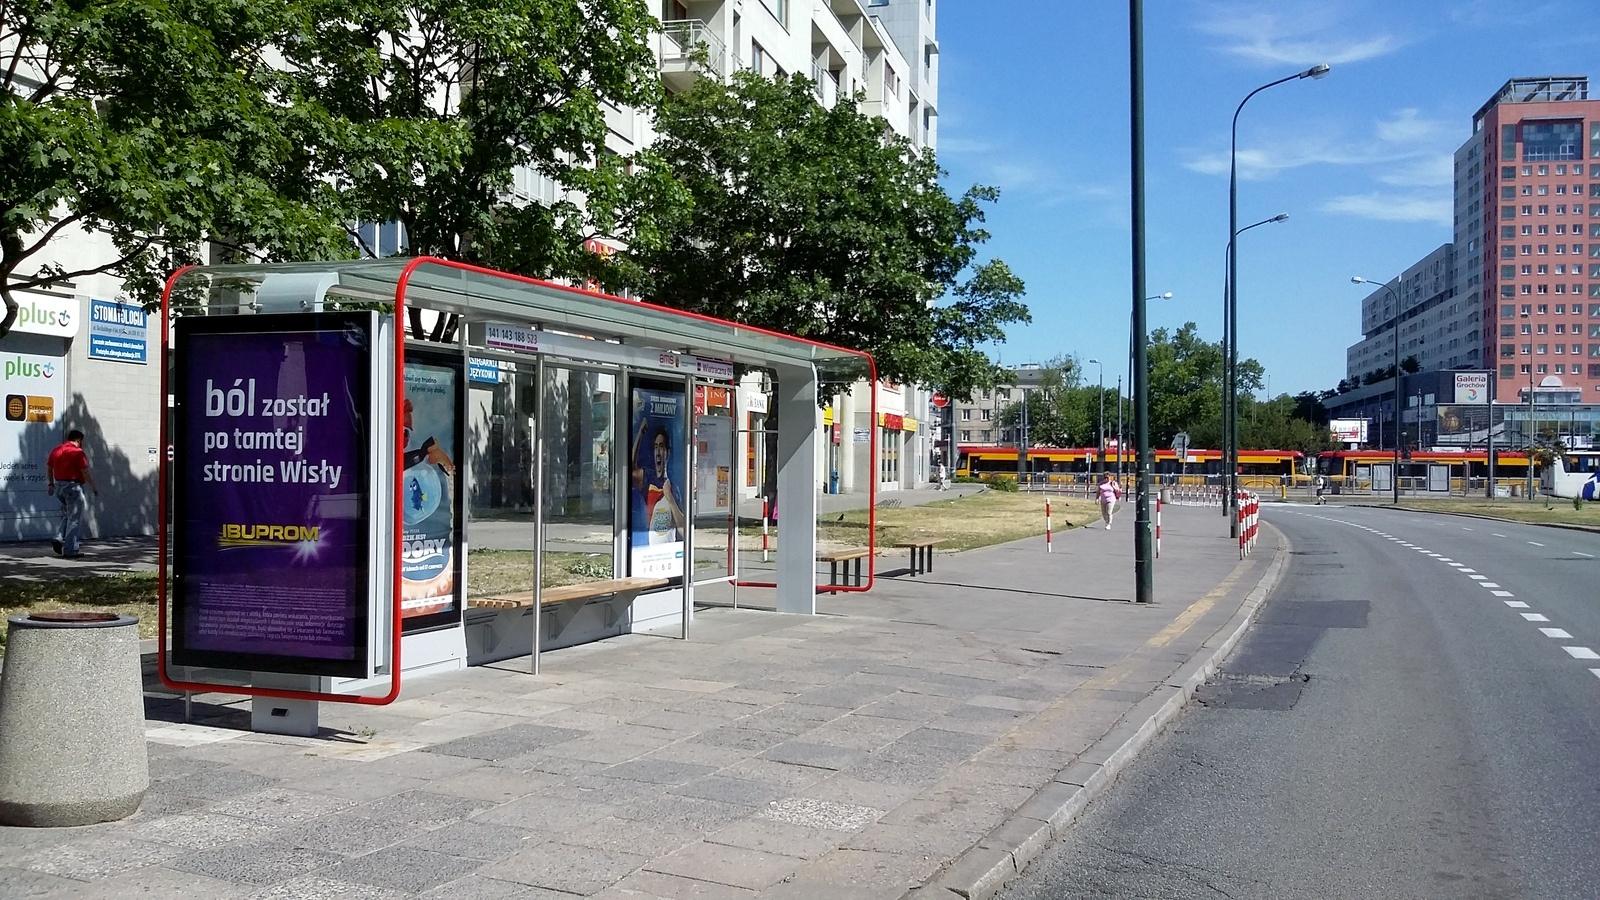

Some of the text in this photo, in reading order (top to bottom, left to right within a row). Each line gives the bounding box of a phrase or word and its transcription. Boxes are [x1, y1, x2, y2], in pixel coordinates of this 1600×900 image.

[19, 302, 56, 327] plus
[93, 304, 144, 327] STOMATOLOGIA
[488, 327, 499, 338] 141
[501, 329, 513, 341] 143
[527, 333, 538, 345] 523
[5, 355, 41, 380] plus
[1456, 374, 1487, 383] Galeria
[205, 378, 331, 418] ból został
[710, 391, 726, 399] ING
[204, 425, 304, 455] po tamtej
[203, 458, 343, 489] stronie Wisły
[221, 523, 320, 542] IBUPROM
[402, 538, 446, 559] DORY
